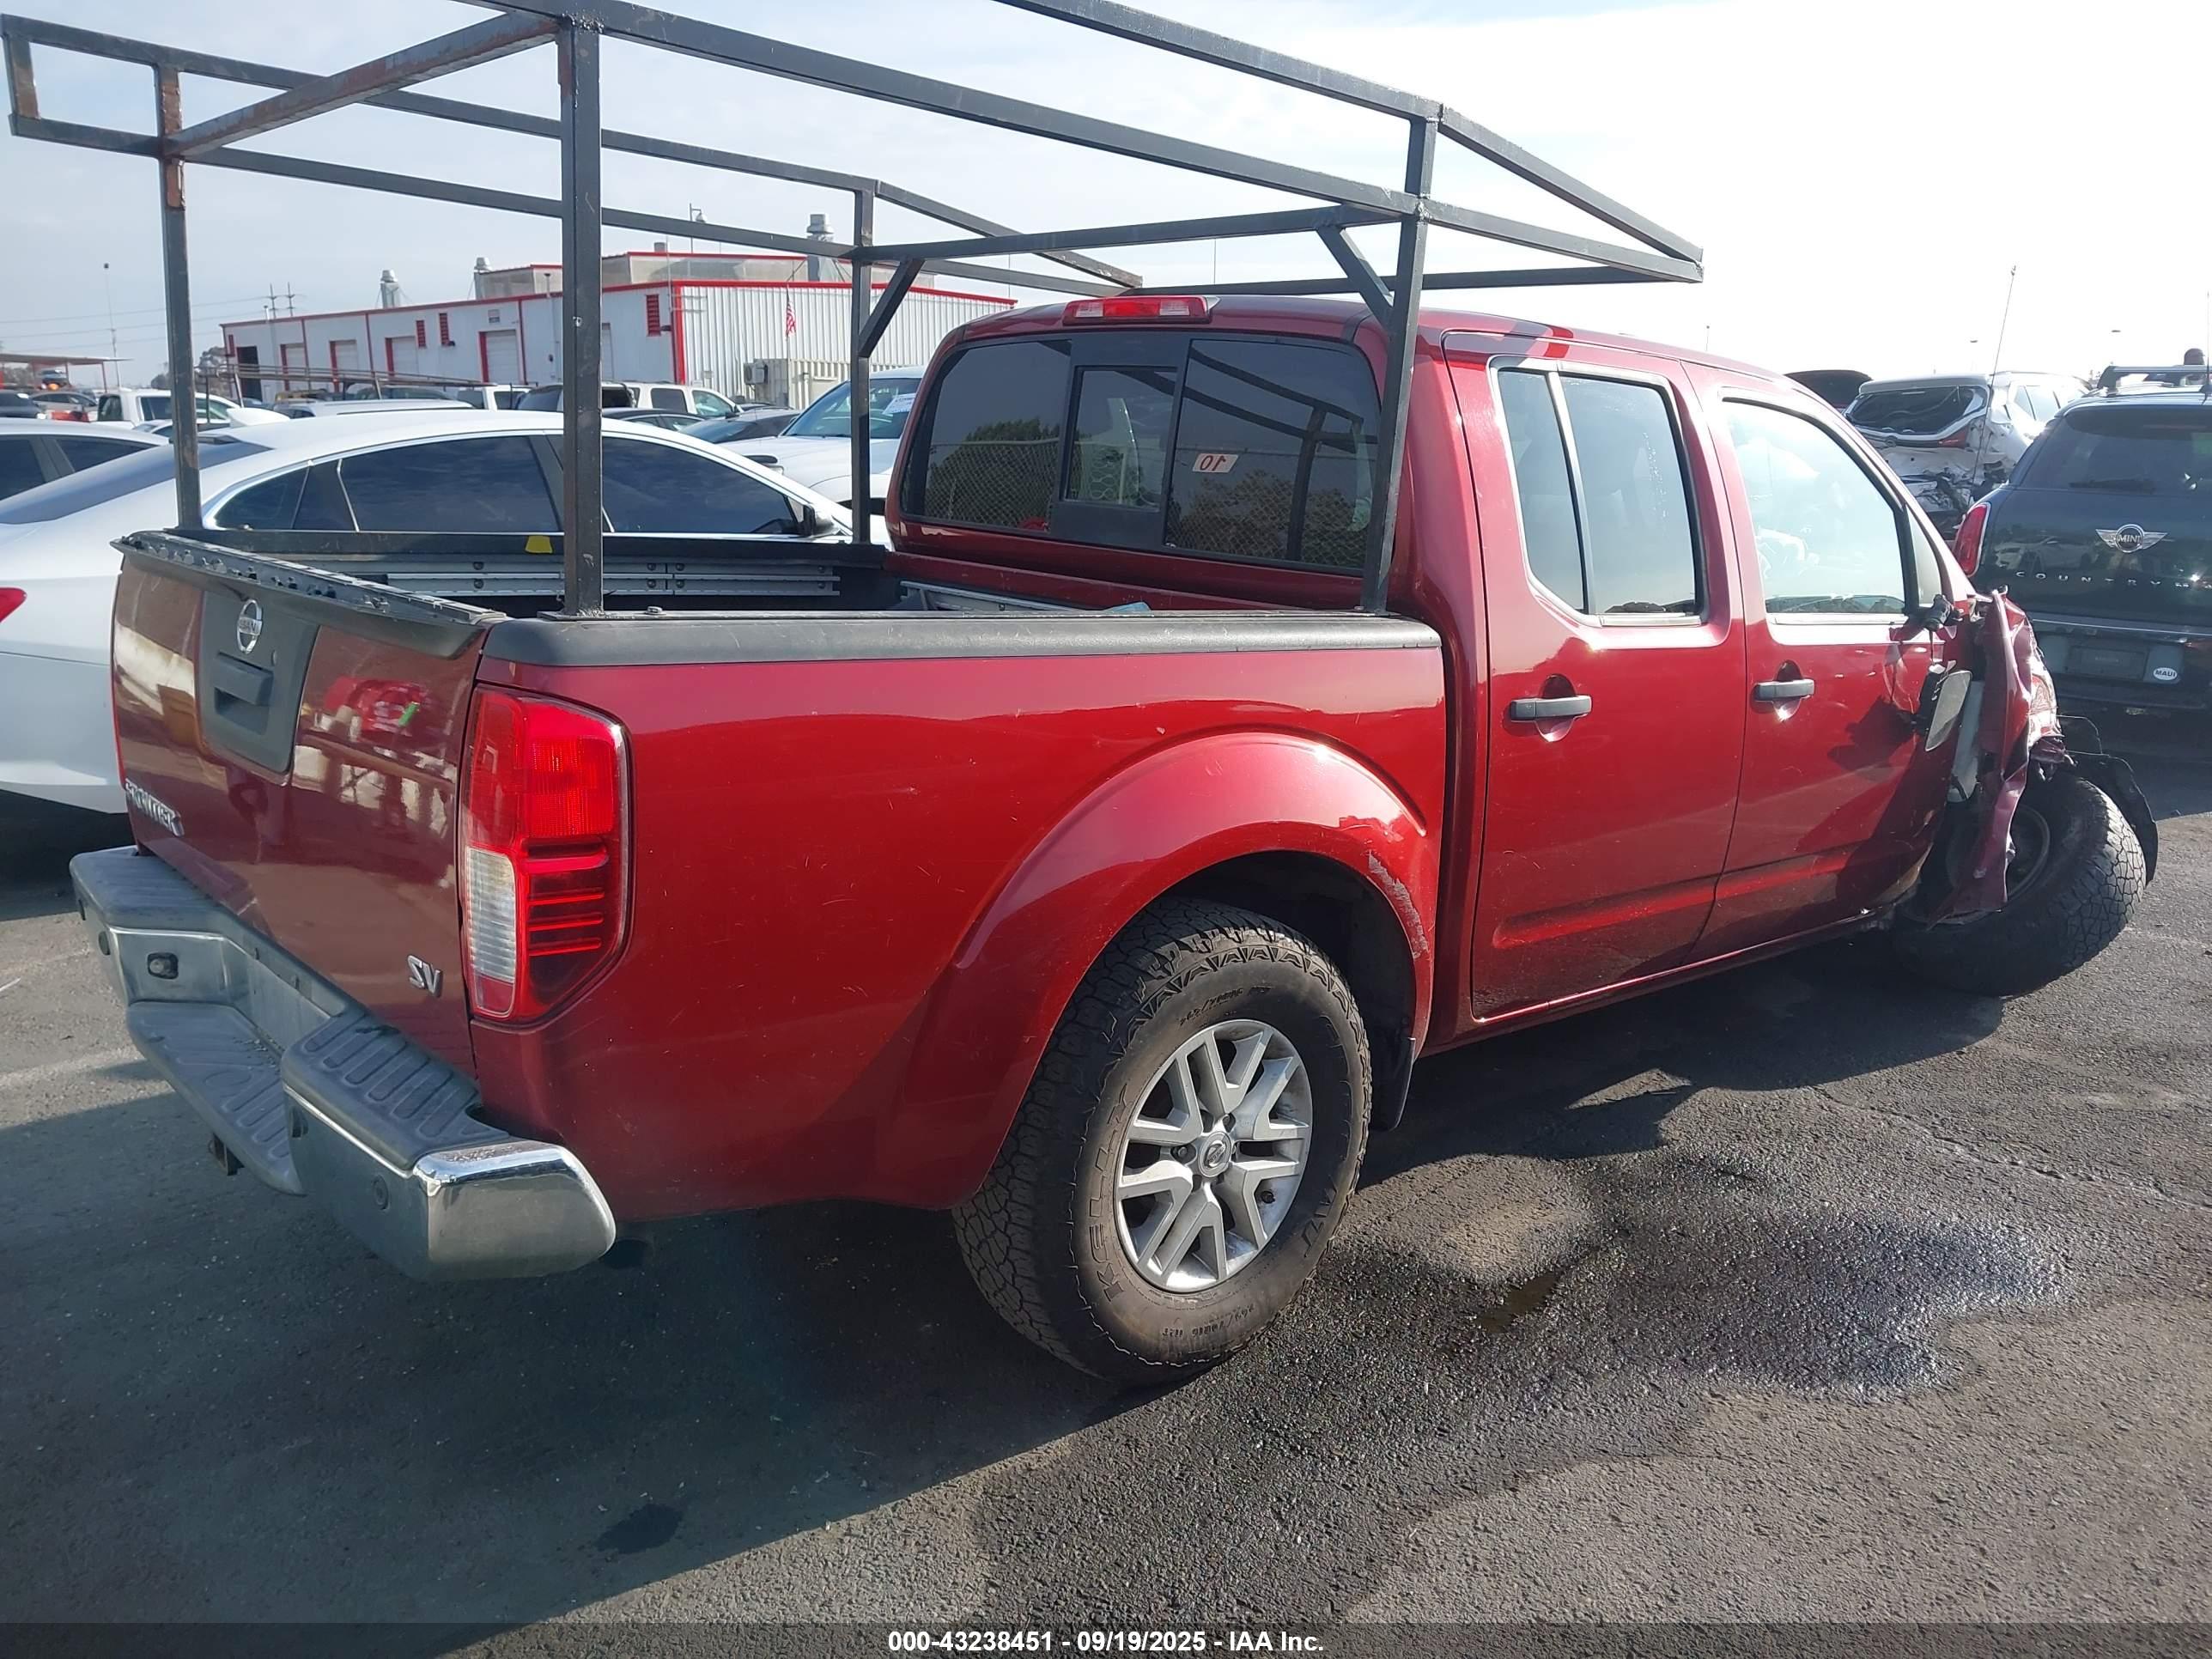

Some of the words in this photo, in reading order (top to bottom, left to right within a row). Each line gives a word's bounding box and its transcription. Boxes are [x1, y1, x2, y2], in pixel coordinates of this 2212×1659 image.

[2118, 533, 2143, 544] MINI
[2155, 669, 2177, 678] MAUI
[407, 955, 443, 994] SV
[1089, 1081, 1127, 1302] KELLY
